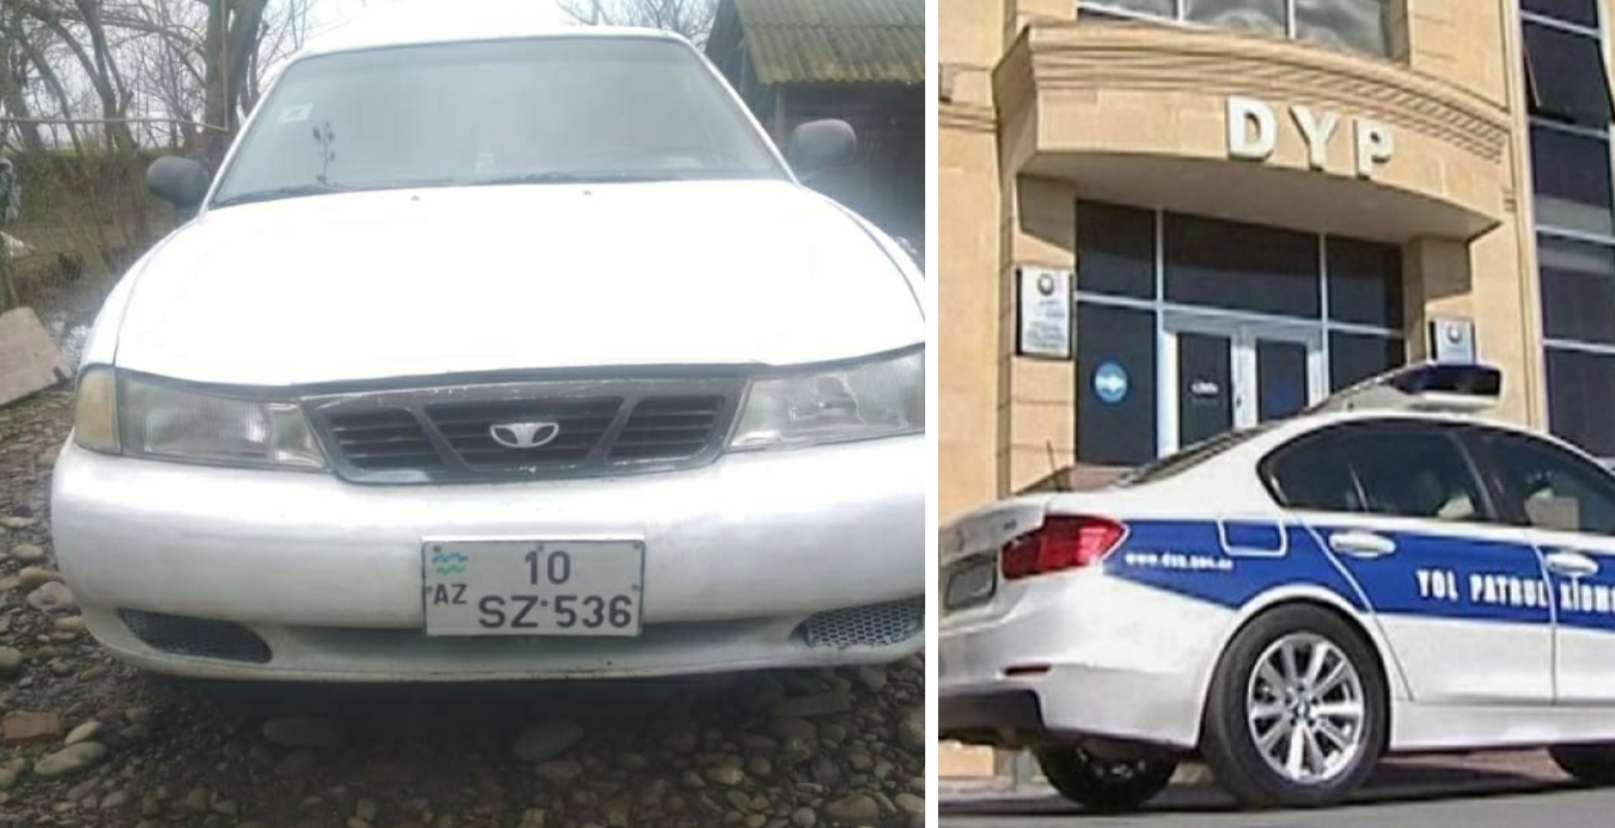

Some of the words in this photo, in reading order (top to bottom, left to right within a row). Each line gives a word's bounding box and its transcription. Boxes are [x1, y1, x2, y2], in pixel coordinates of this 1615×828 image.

[1225, 95, 1393, 180] DYP
[524, 550, 571, 585] 10
[433, 583, 468, 605] AZ
[1415, 568, 1459, 600] YOL
[1469, 573, 1549, 607] PATRUL
